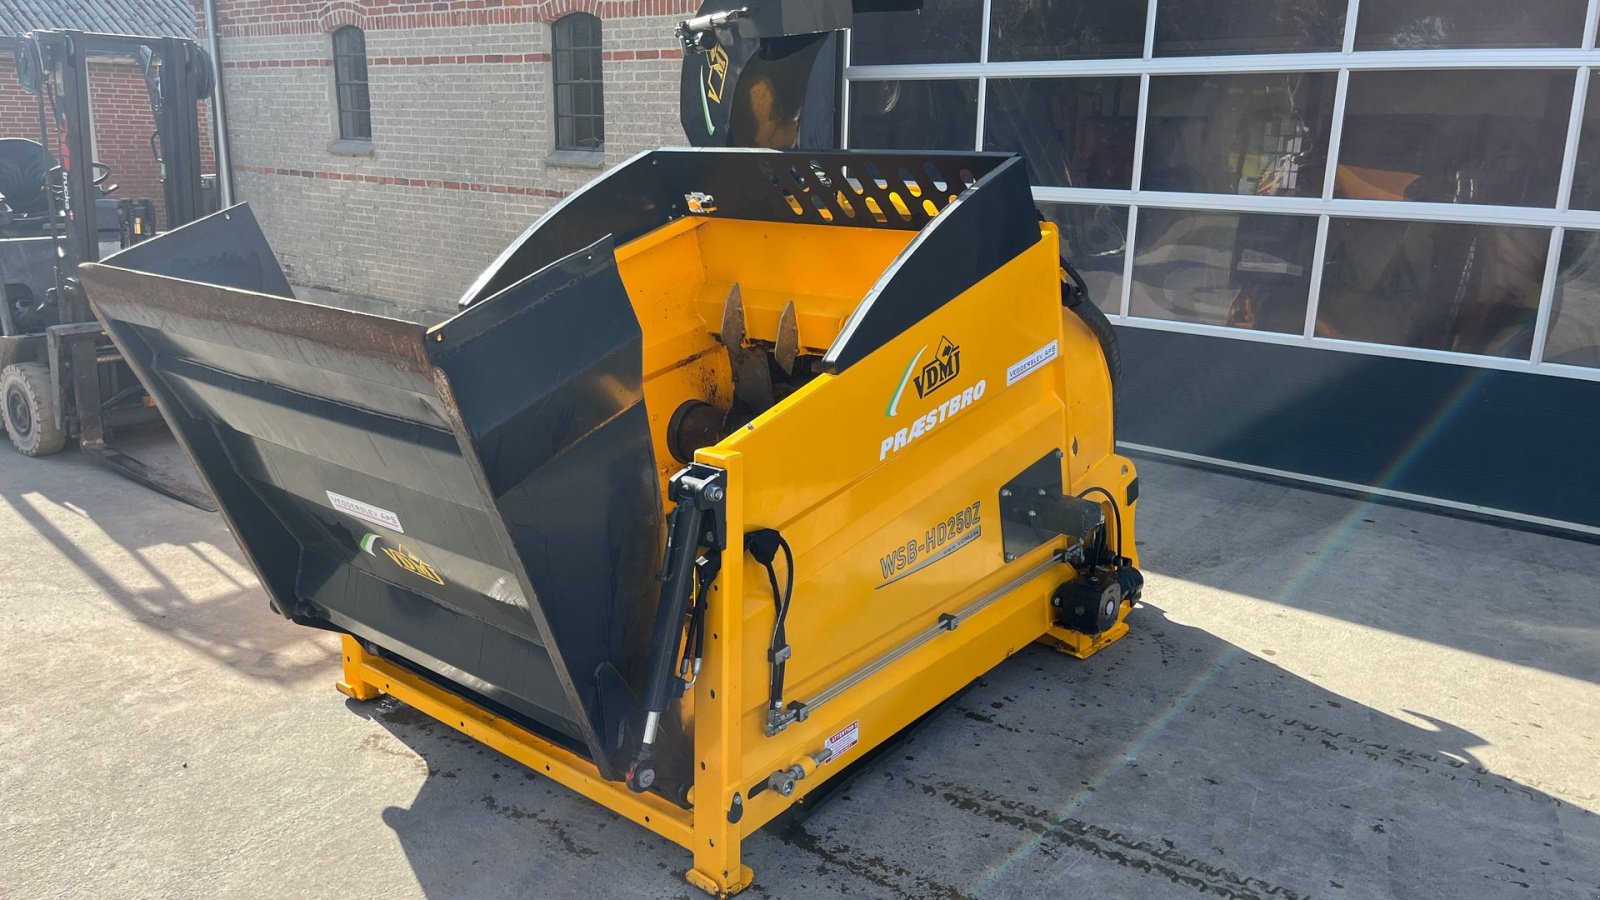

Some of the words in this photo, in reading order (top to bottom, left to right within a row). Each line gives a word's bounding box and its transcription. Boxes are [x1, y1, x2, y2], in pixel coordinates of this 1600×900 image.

[62, 171, 71, 210] trucks
[913, 345, 960, 399] VDMJ
[879, 379, 986, 461] PRÆSTBRO
[880, 500, 981, 579] WSB-HD250Z
